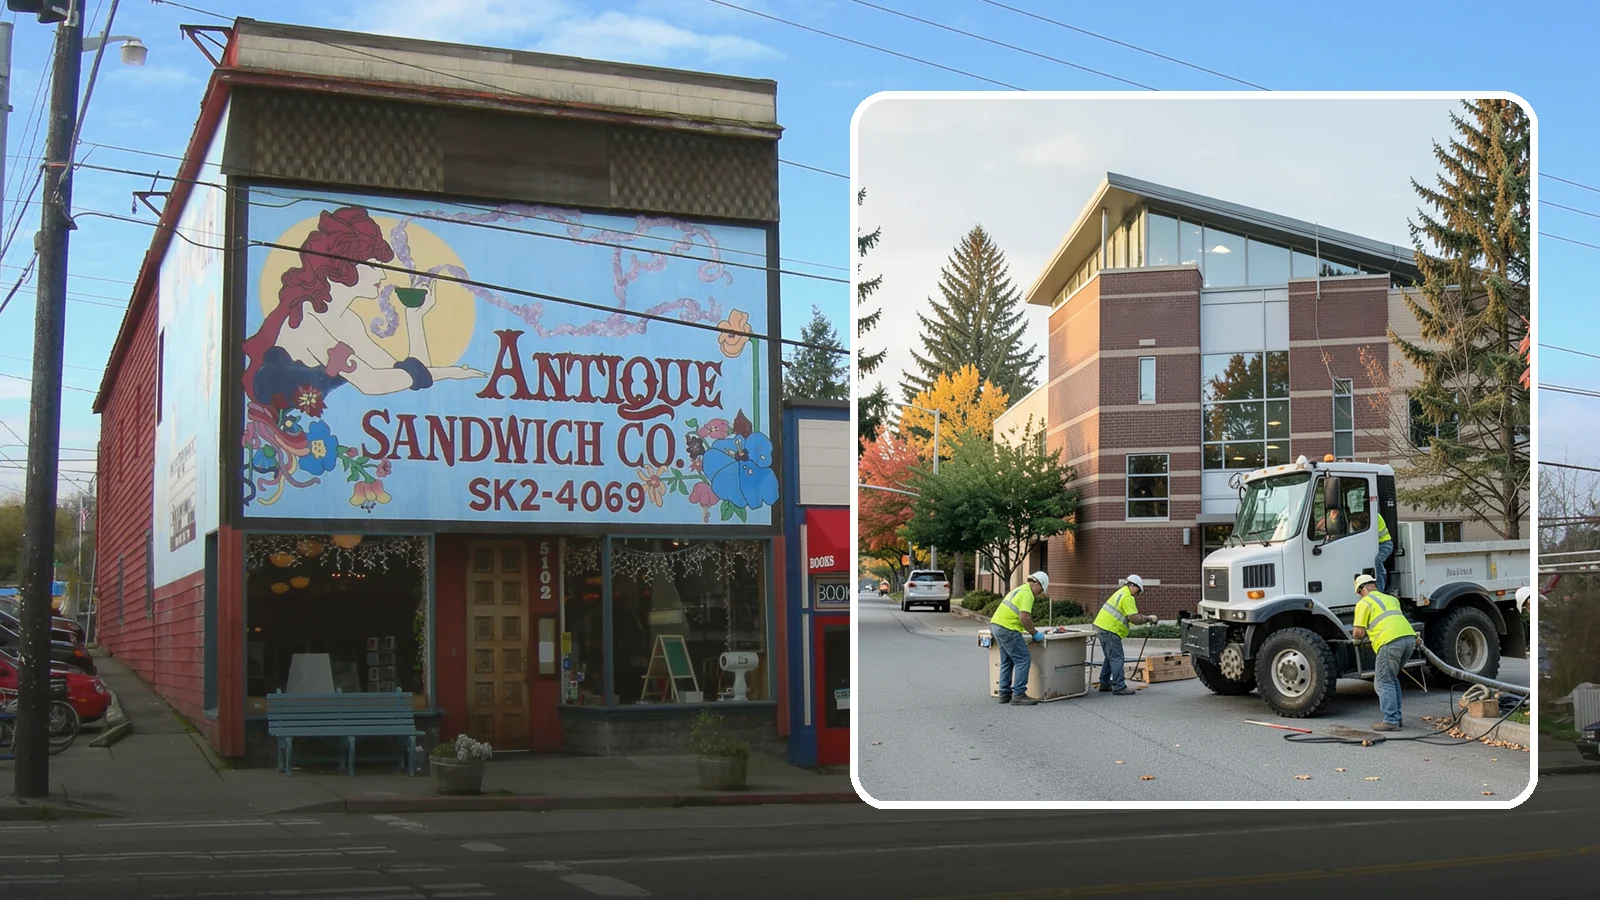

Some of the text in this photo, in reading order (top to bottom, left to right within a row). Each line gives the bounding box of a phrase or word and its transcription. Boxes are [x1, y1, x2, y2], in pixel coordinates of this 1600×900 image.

[476, 329, 723, 420] ANTIQUE
[361, 408, 685, 468] SANDWICH CO.
[468, 477, 646, 513] SK2-4069
[540, 541, 551, 600] 5102
[809, 555, 835, 569] BOOKS
